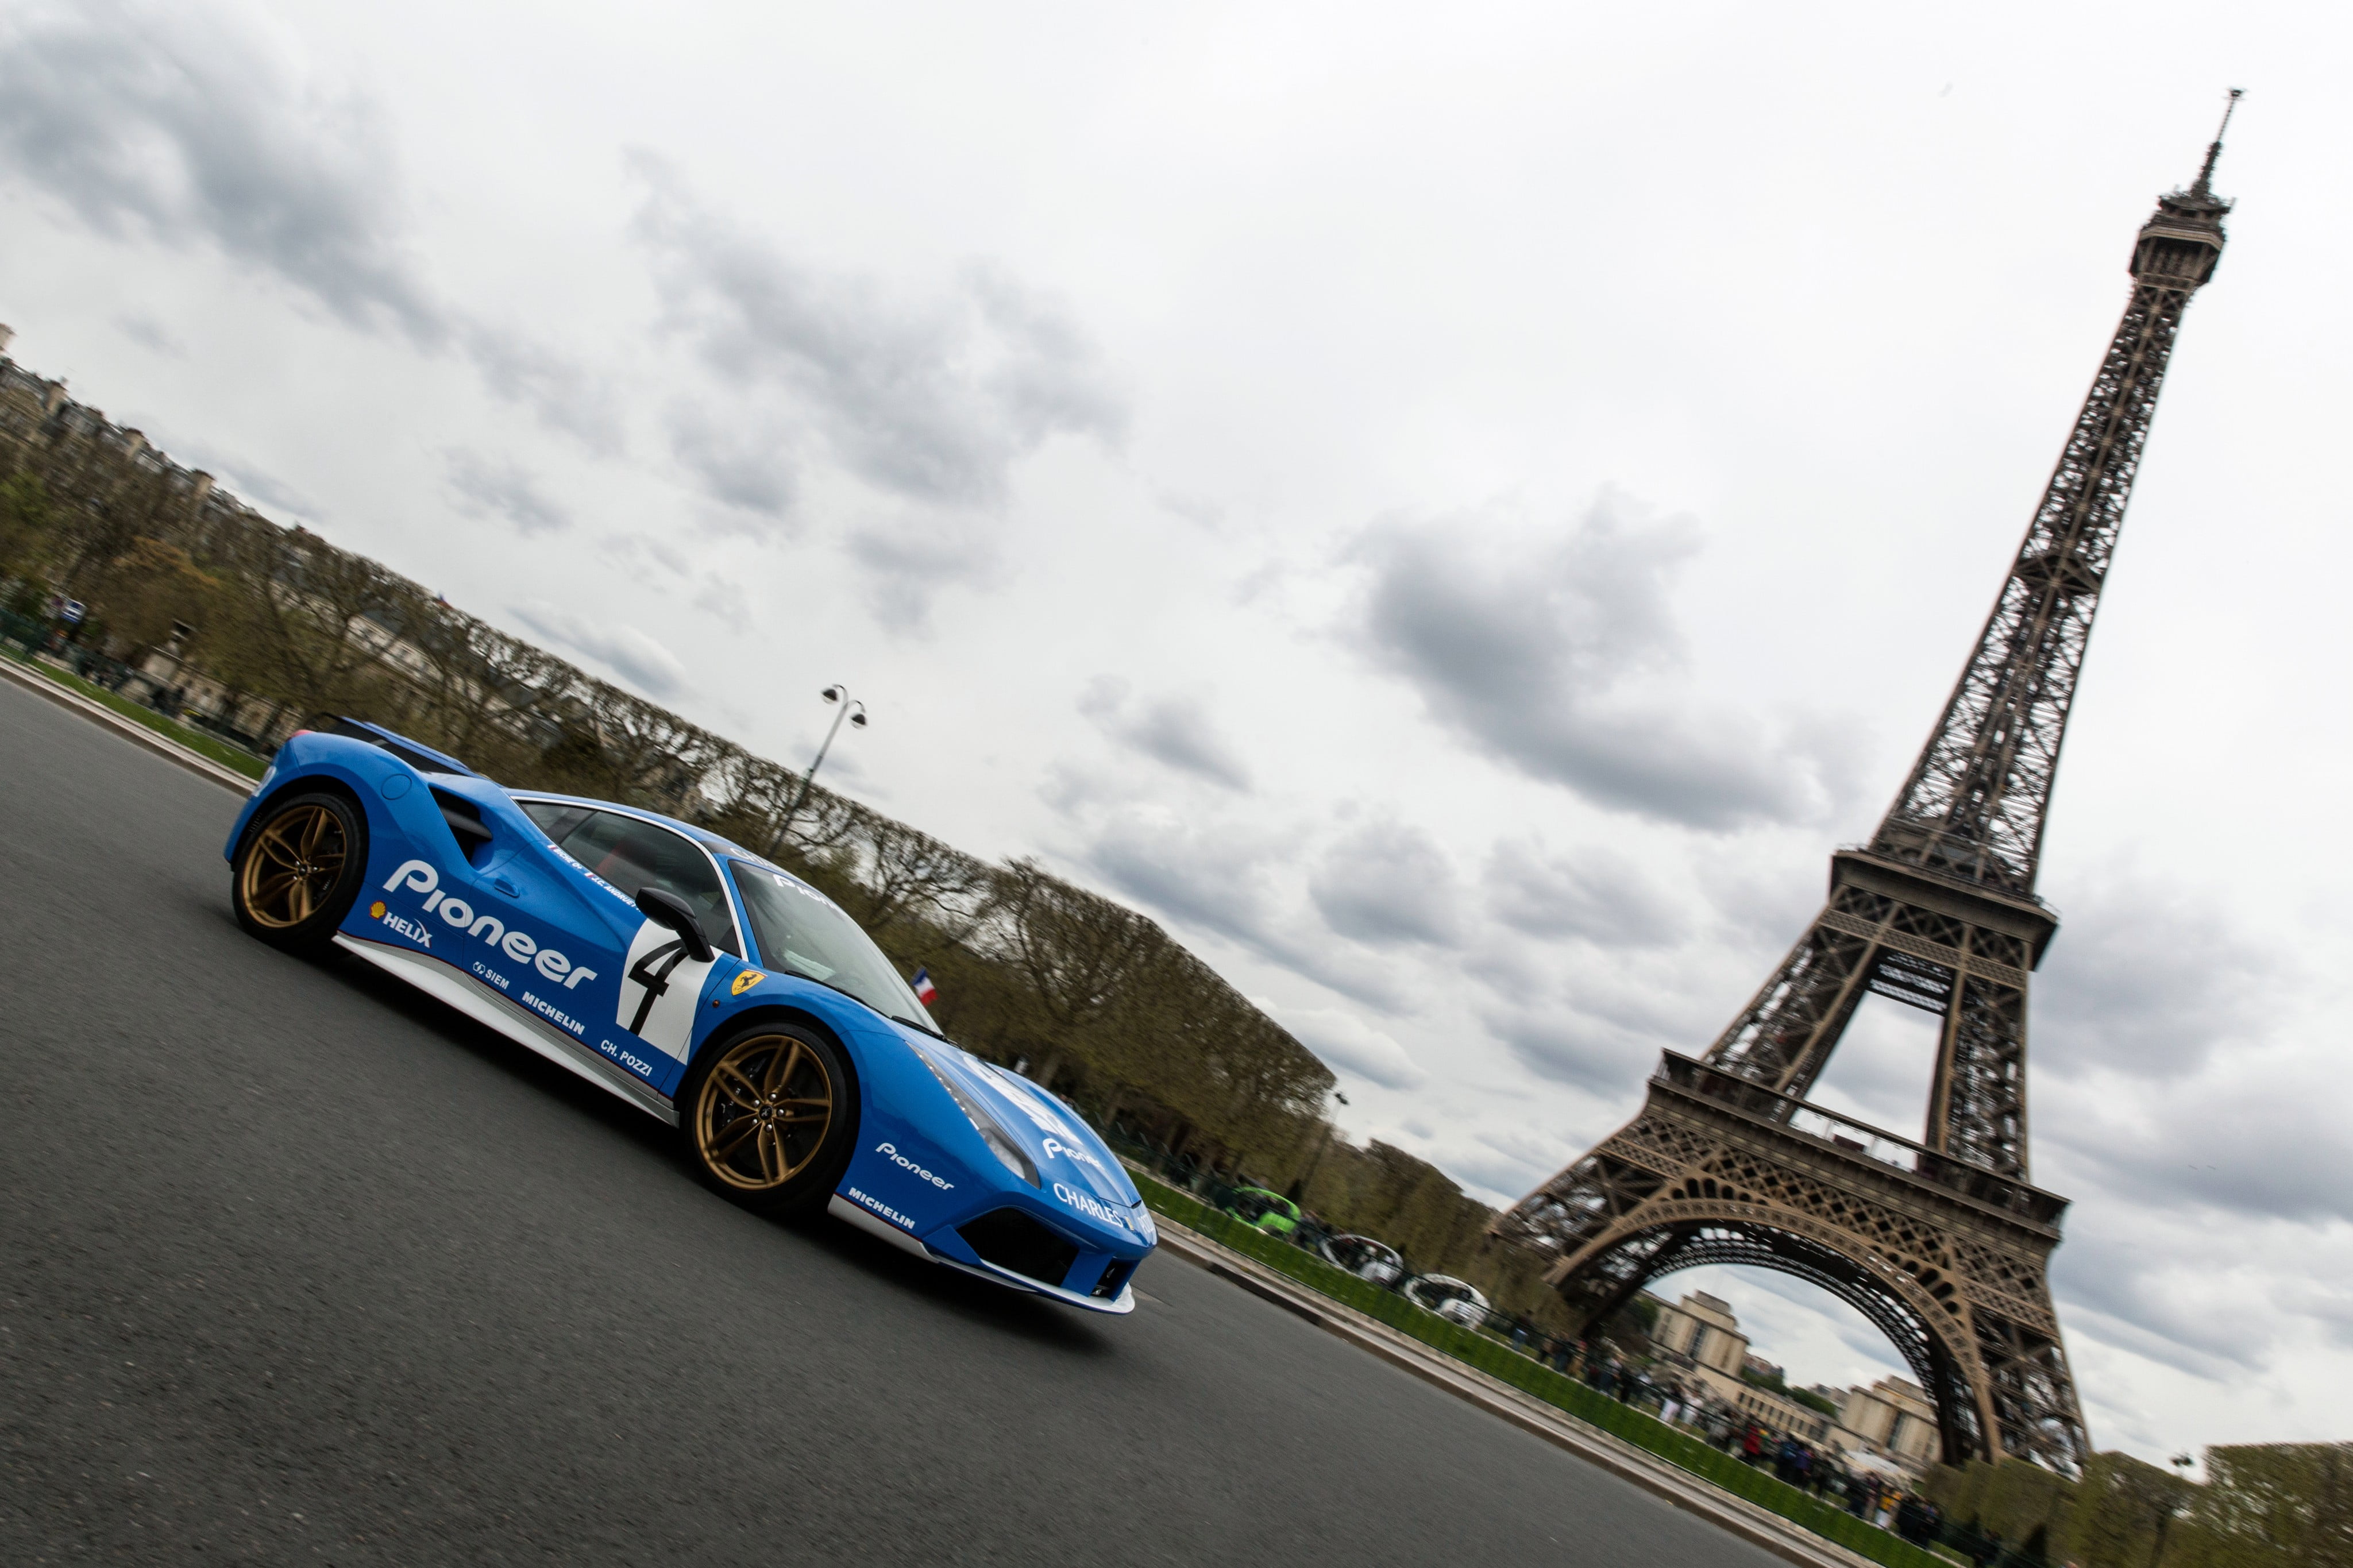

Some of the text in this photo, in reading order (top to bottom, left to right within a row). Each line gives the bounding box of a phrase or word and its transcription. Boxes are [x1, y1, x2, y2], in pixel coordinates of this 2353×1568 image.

[603, 886, 636, 907] ANDRUET
[773, 874, 846, 916] Pion
[382, 912, 433, 948] HELIX
[383, 860, 597, 990] Pioneer
[485, 969, 510, 990] SIEM
[628, 939, 689, 1036] 4
[522, 991, 585, 1035] MICHELIN
[600, 1040, 653, 1077] CH. POZZI
[875, 1142, 954, 1191] Pioneer
[848, 1187, 915, 1230] MICHELIN
[1054, 1183, 1124, 1227] CHARLES
